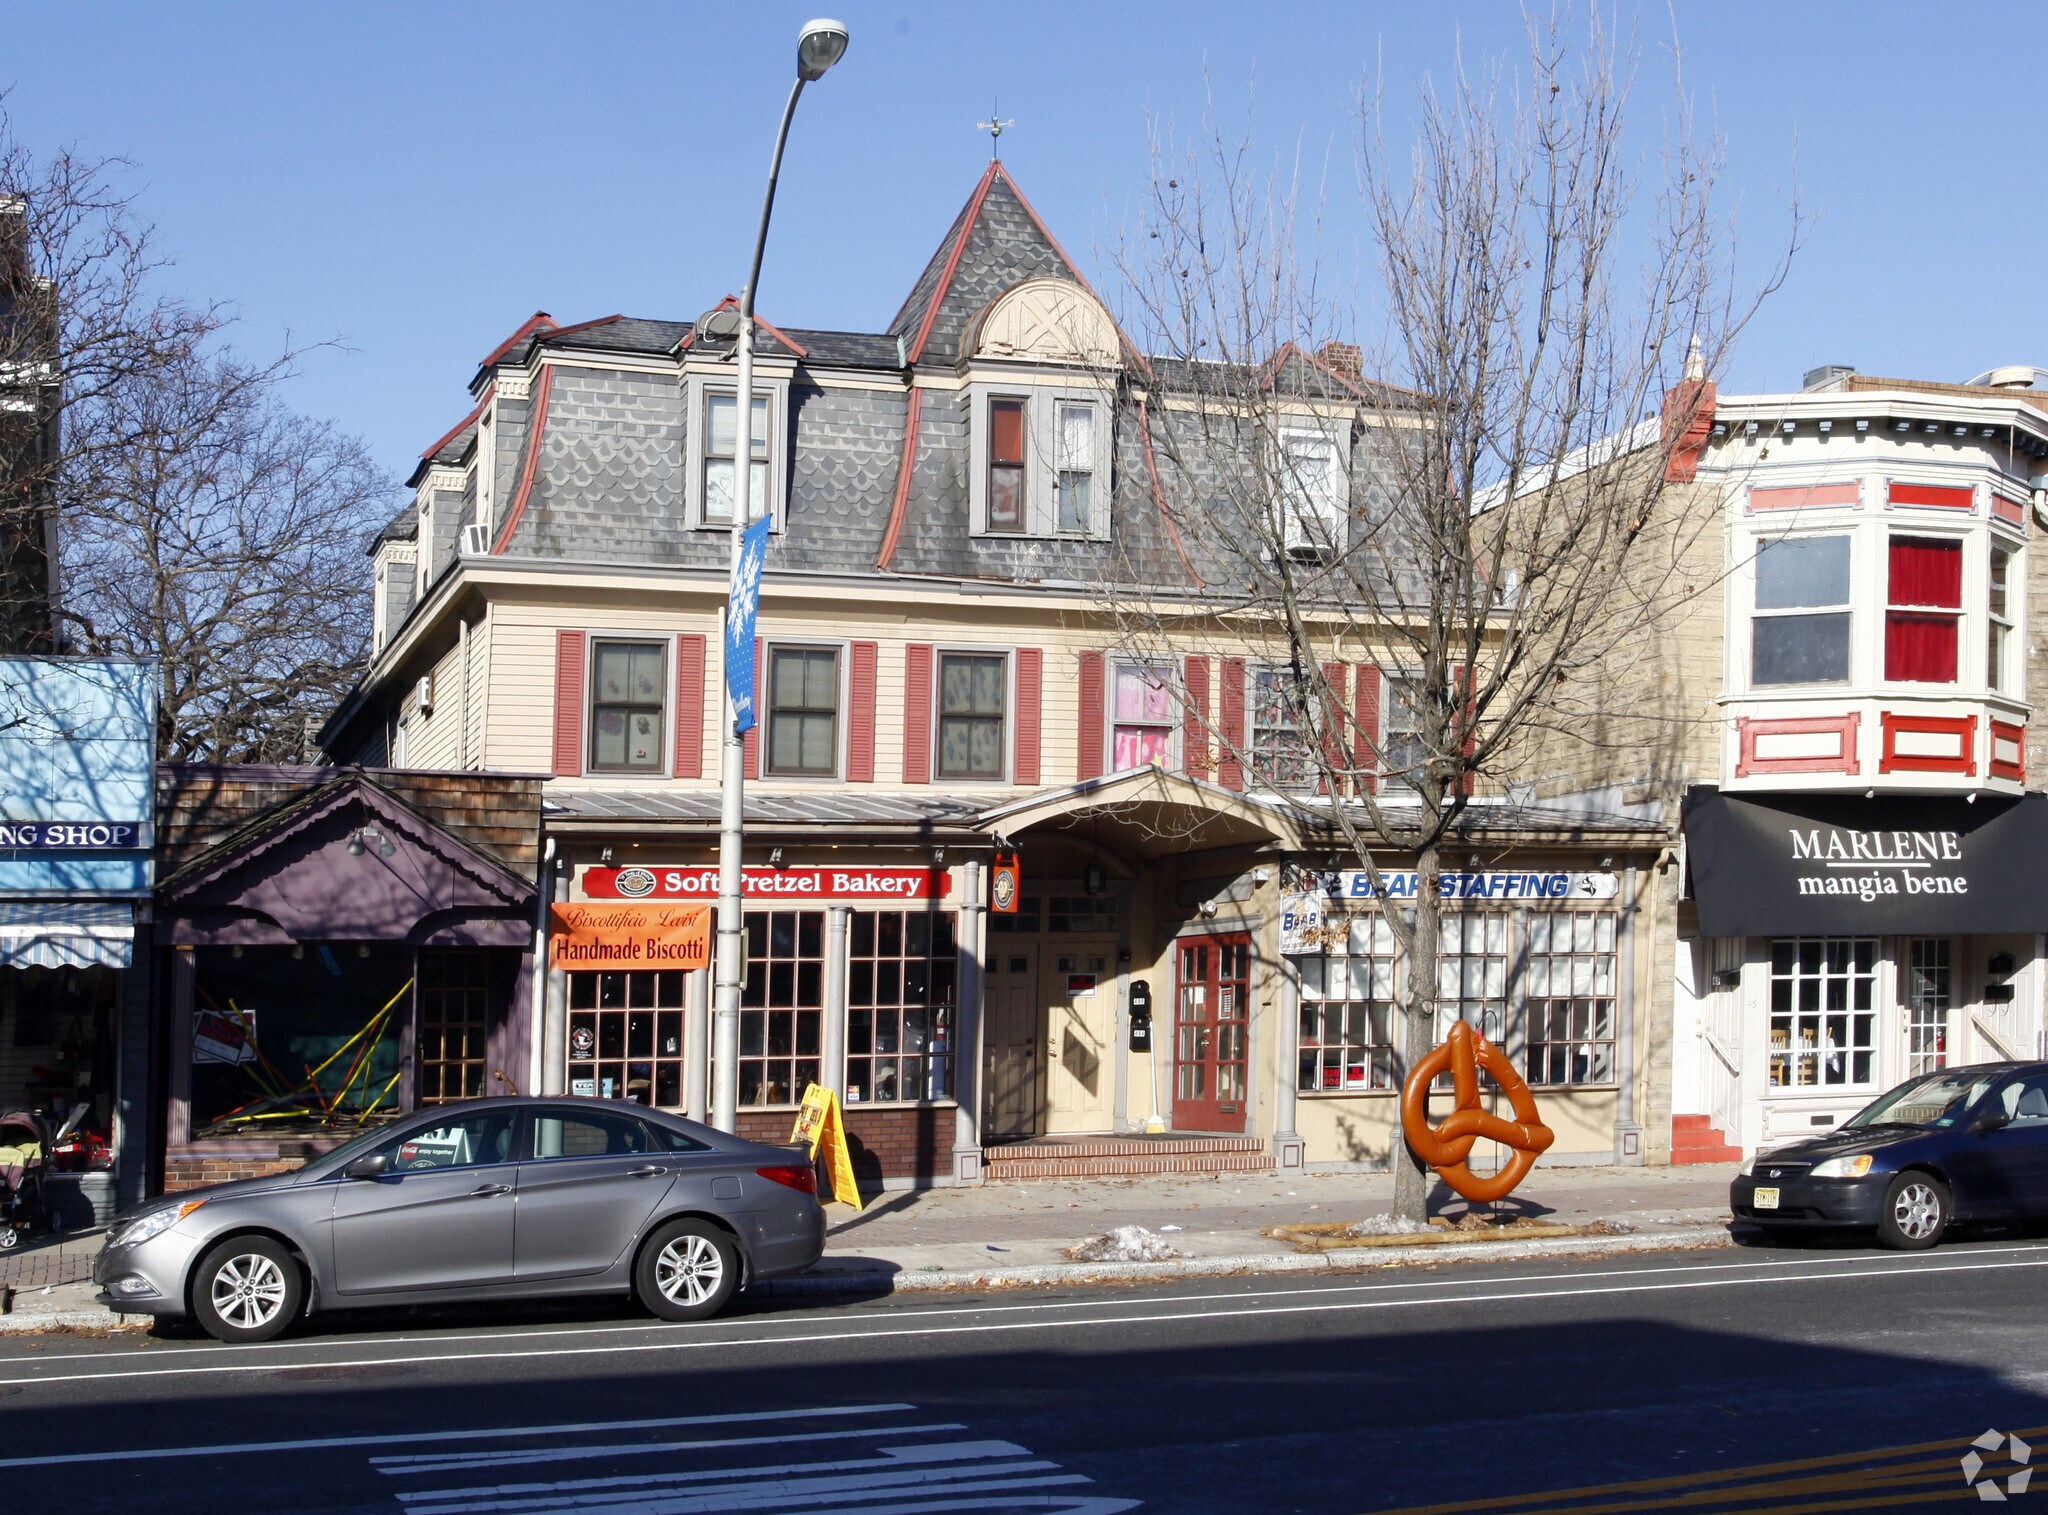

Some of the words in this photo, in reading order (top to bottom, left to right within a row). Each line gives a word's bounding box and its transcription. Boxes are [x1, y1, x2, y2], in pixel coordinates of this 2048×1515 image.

[44, 825, 131, 845] SHOP
[1789, 829, 1962, 860] MARLENE
[664, 871, 720, 893] Soft
[832, 873, 922, 897] Bakery
[1438, 873, 1569, 898] STAFFING
[1798, 870, 1899, 902] mangia
[1901, 868, 1968, 894] bene
[567, 906, 647, 933] Biscottificio
[556, 936, 641, 961] Handmade
[646, 937, 703, 961] Biscotti
[432, 1148, 454, 1156] together
